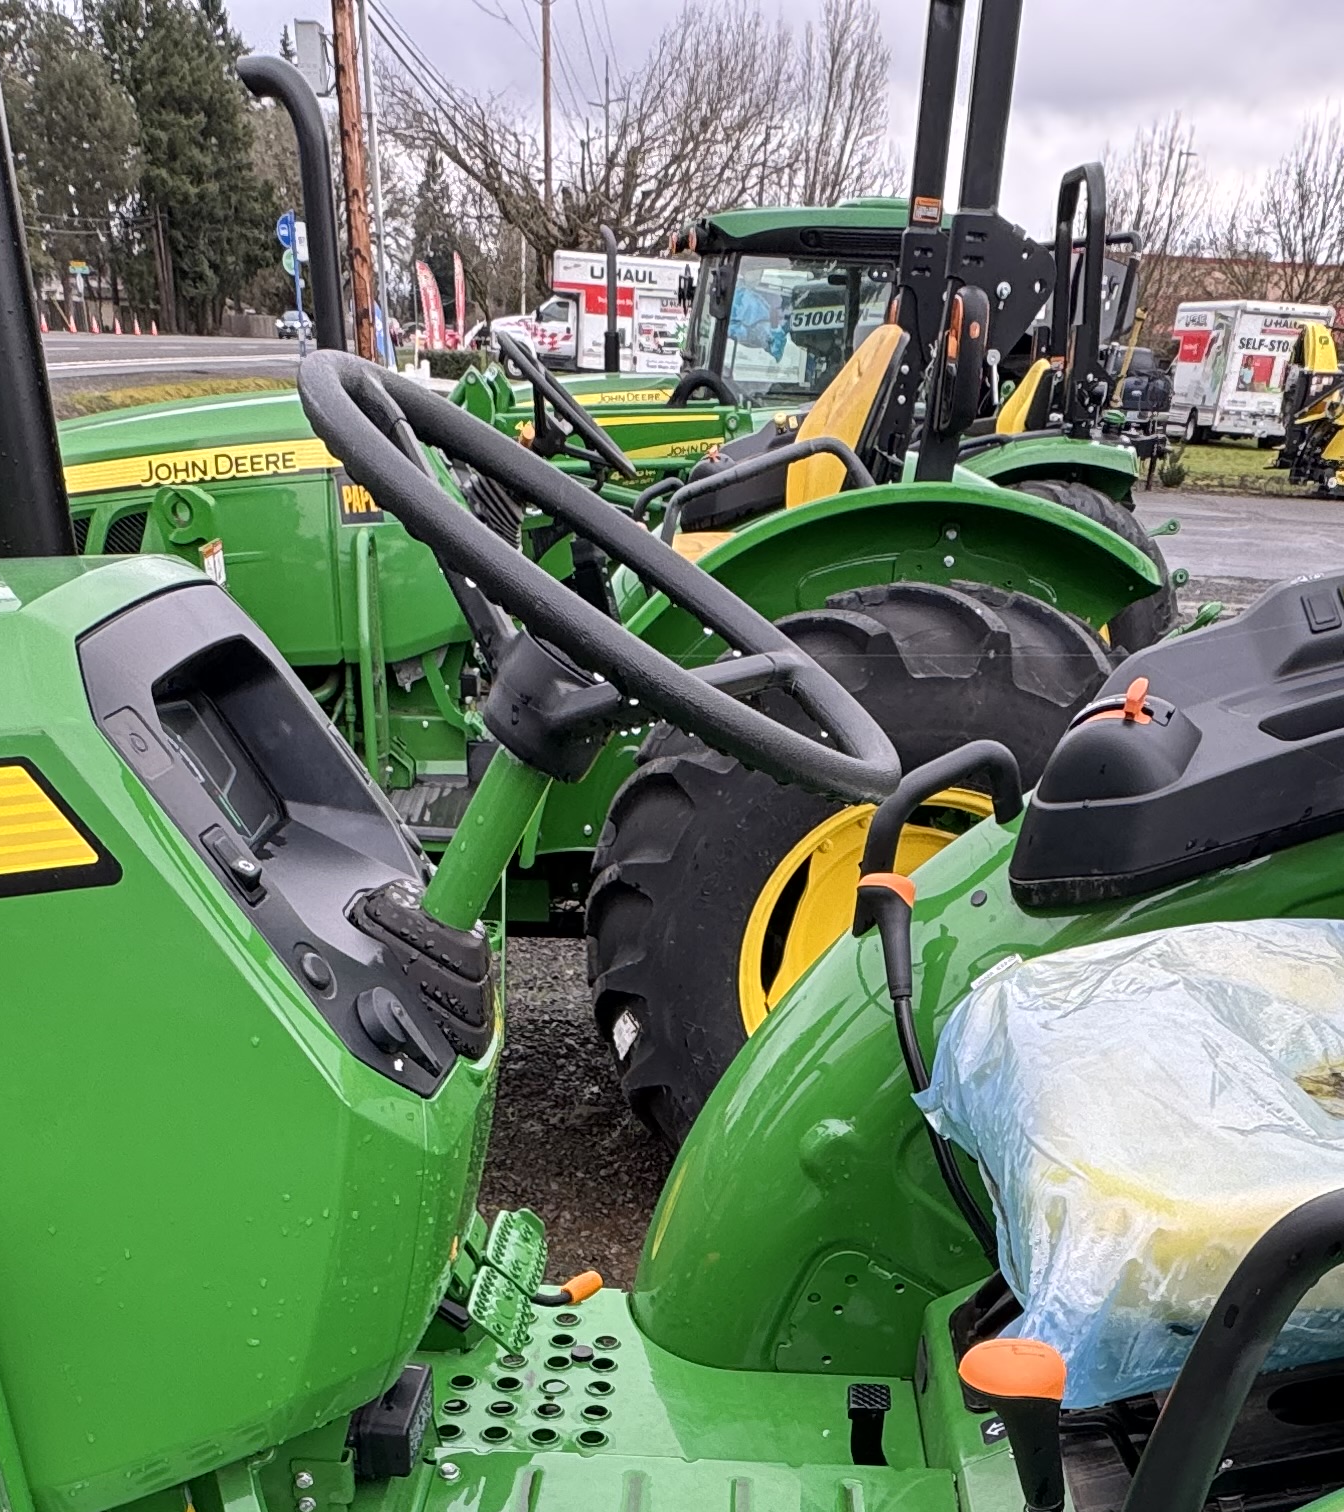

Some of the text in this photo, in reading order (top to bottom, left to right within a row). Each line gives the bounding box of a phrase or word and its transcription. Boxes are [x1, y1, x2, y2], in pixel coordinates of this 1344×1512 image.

[590, 266, 658, 285] UHAUL
[1238, 336, 1292, 353] SELF-STO
[598, 392, 626, 404] JOHN
[666, 444, 699, 457] JOHN
[141, 451, 297, 483] JOHN DEERE
